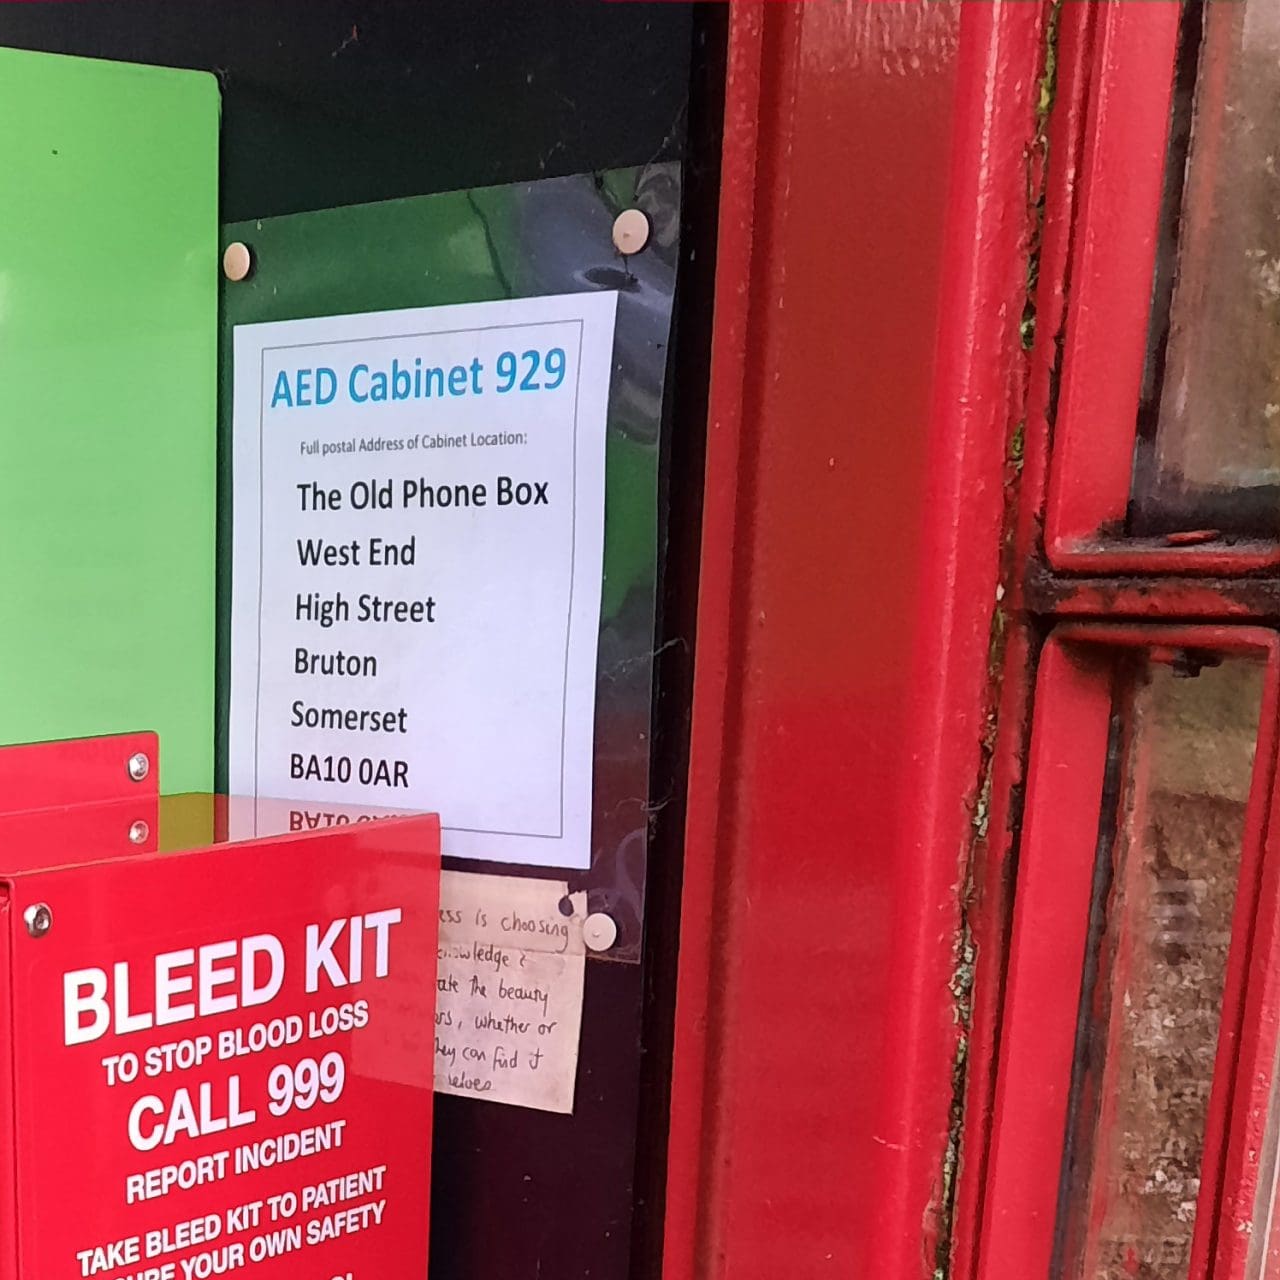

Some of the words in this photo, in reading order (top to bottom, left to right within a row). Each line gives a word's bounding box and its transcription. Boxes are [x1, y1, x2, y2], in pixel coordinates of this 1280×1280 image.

[271, 367, 337, 408] AED
[349, 357, 484, 402] Cabinet
[495, 348, 566, 392] 929
[300, 439, 319, 455] Full
[322, 436, 355, 457] postal
[359, 435, 404, 452] Address
[407, 434, 419, 449] of
[422, 433, 467, 450] Cabinet
[471, 431, 527, 448] Location:
[297, 482, 341, 511] The
[350, 479, 393, 509] Old
[403, 478, 487, 508] Phone
[497, 477, 549, 506] Box
[297, 538, 360, 566] West
[369, 536, 415, 566] End
[296, 594, 349, 628] High
[358, 594, 435, 623] Street
[295, 648, 377, 677] Bruton
[291, 700, 408, 733] Somerset
[290, 754, 351, 784] BA10
[359, 758, 409, 787] 0AR
[475, 908, 487, 927] is
[501, 911, 568, 953] choosing
[63, 933, 285, 1046] BLEED
[305, 908, 402, 993] KIT
[475, 1011, 529, 1034] whether
[538, 1021, 557, 1035] or
[101, 1053, 139, 1086] TO
[144, 1036, 212, 1077] STOP
[219, 1011, 303, 1061] BLOOD
[309, 1000, 369, 1039] LOSS
[463, 1046, 486, 1062] can
[493, 1046, 518, 1072] find
[128, 1075, 257, 1152] CALL
[268, 1051, 345, 1117] 999
[127, 1152, 230, 1205] REPORT
[235, 1120, 347, 1175] INCIDENT
[76, 1244, 140, 1277] TAKE
[145, 1214, 221, 1268] BLEED
[227, 1202, 263, 1236] KIT
[267, 1191, 297, 1222] TO
[302, 1165, 388, 1212] PATIENT
[249, 1225, 302, 1262] OWN
[306, 1200, 386, 1246] SAFETY
